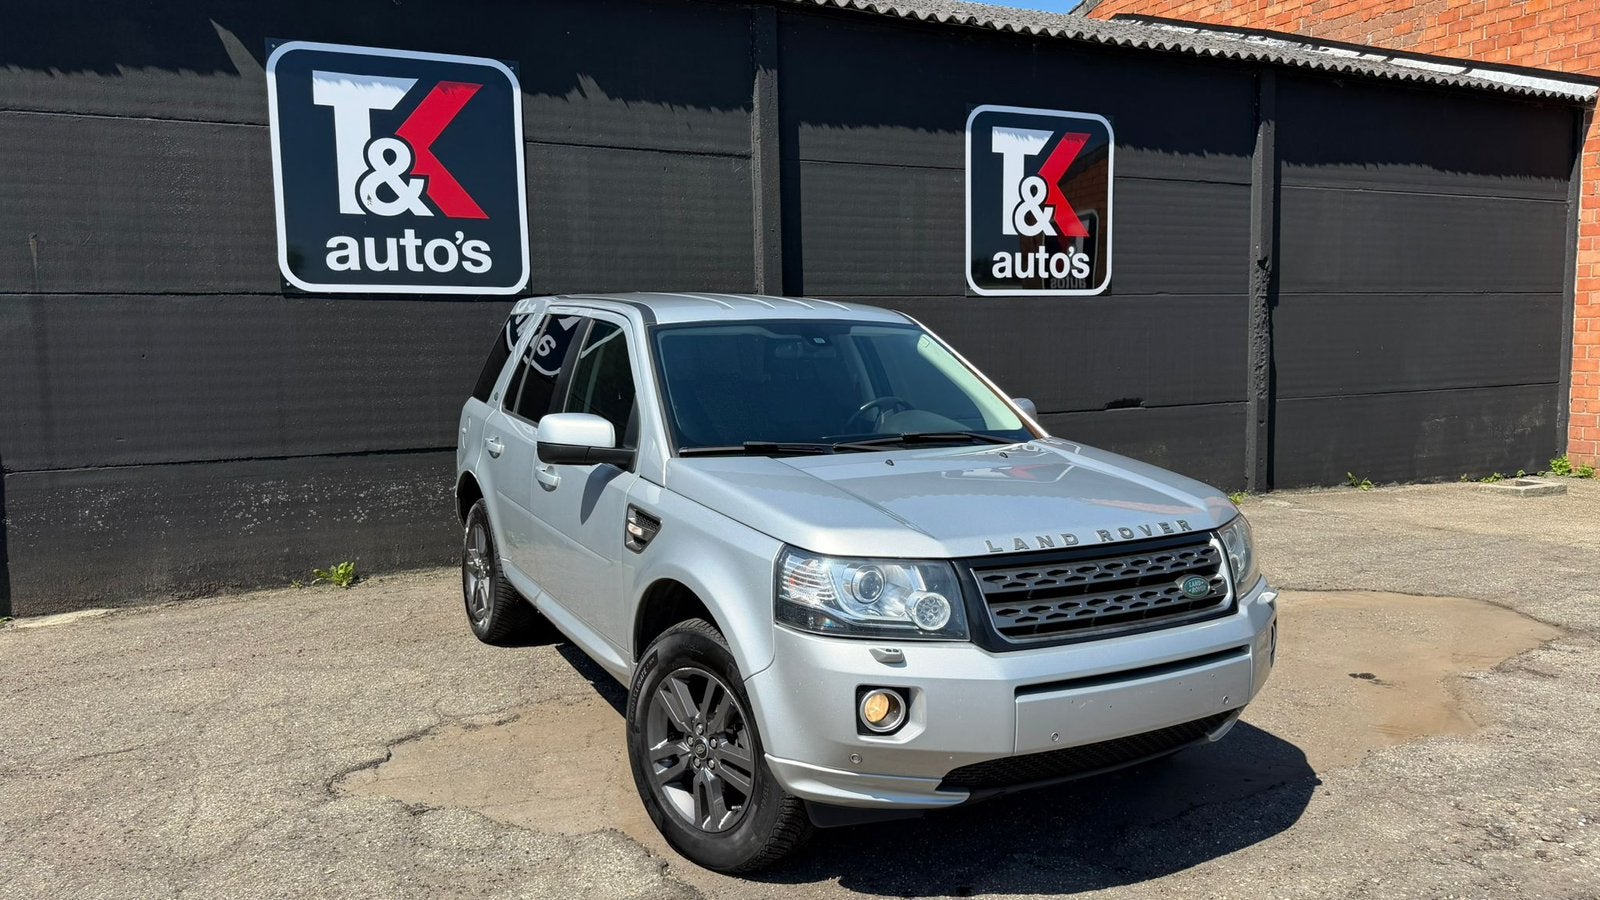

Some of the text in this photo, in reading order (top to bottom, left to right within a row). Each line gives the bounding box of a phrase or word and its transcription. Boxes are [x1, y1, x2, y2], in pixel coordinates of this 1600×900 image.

[312, 69, 490, 220] T&K
[992, 126, 1091, 237] T&K
[325, 228, 493, 274] auto's
[992, 246, 1090, 279] auto's
[984, 519, 1193, 553] LAND ROVER
